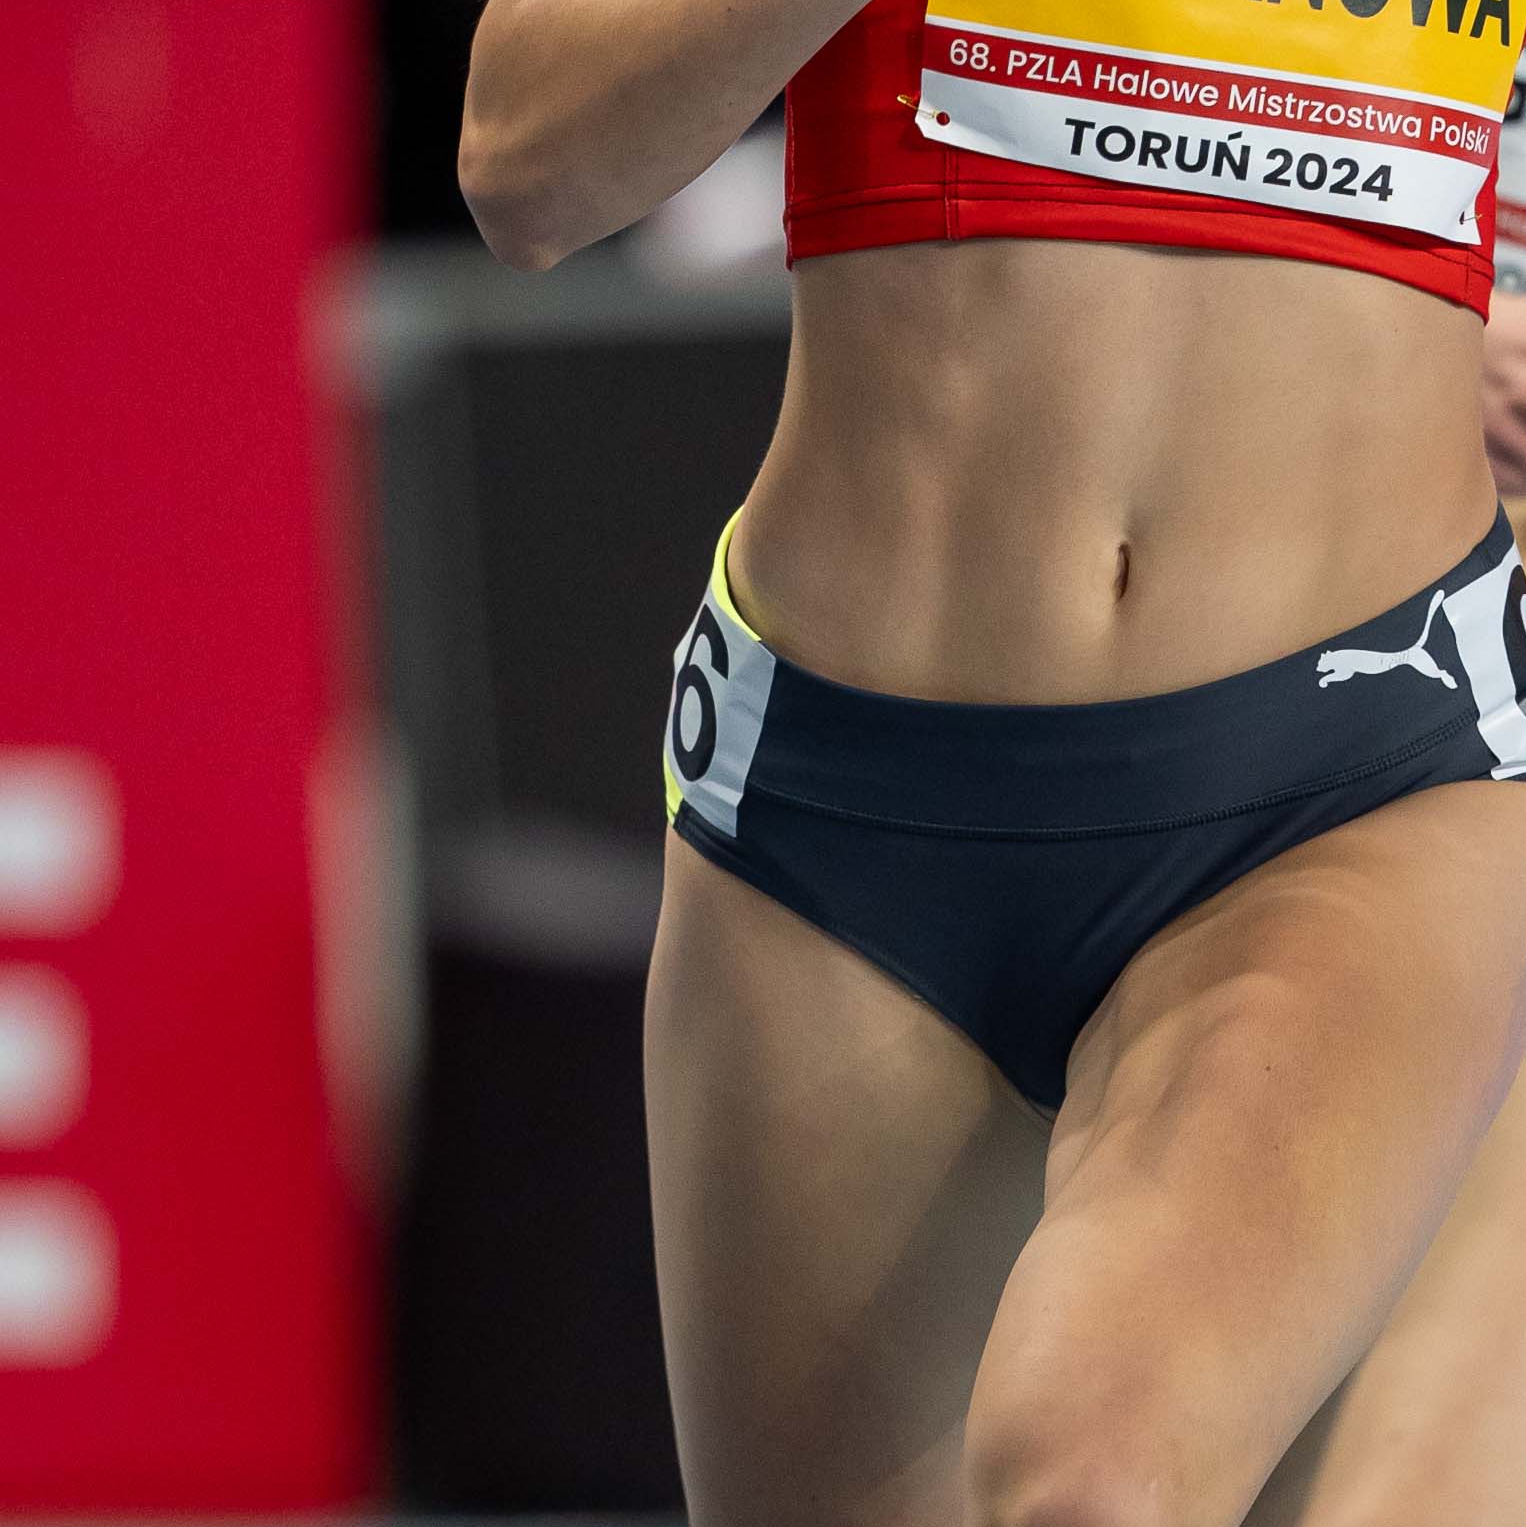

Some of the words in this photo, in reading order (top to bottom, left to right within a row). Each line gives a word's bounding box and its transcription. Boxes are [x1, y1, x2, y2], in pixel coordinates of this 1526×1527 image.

[950, 38, 996, 72] 68.
[1007, 49, 1083, 88] PZLA
[1093, 63, 1219, 107] Halowe
[1228, 84, 1422, 139] Mistrzostwa
[1429, 116, 1491, 155] Polski
[1065, 117, 1251, 182] TORUŃ
[1262, 148, 1394, 202] 2024
[672, 602, 729, 782] 6
